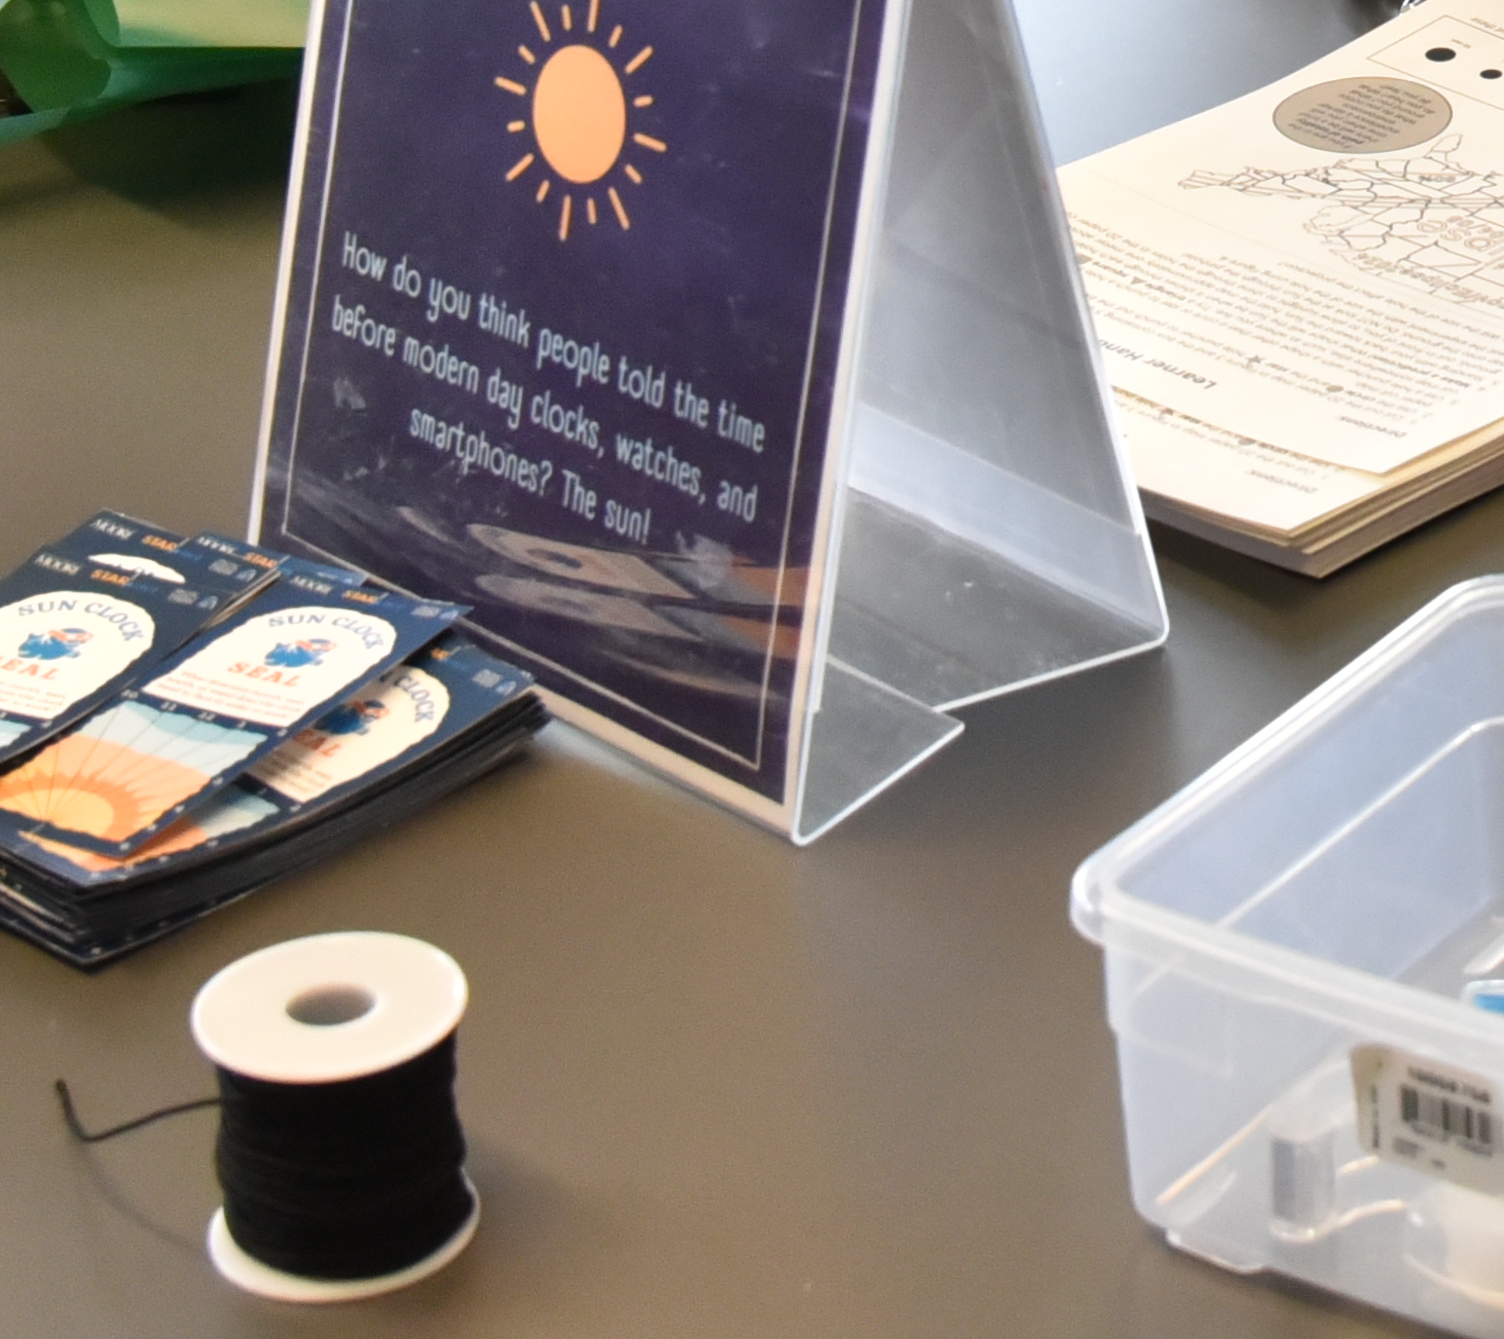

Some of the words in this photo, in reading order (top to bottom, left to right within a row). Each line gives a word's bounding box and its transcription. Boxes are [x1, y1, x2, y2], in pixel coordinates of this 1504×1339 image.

[342, 231, 386, 281] How
[392, 254, 422, 299] do
[428, 277, 471, 323] you
[478, 292, 531, 351] think
[537, 327, 612, 388] people
[618, 354, 665, 411] told
[674, 378, 710, 429] the
[717, 400, 766, 454] time
[1148, 358, 1216, 390] Learner
[331, 295, 397, 355] before
[402, 335, 480, 395] modern
[487, 370, 524, 424] day
[530, 392, 605, 461] clocks,
[615, 432, 705, 504] watches,
[717, 473, 758, 524] and
[1335, 415, 1408, 438] Directions:
[409, 406, 554, 497] smartphones?
[562, 470, 597, 522] The
[605, 498, 652, 545] sun!
[90, 569, 131, 586] STAR
[17, 599, 78, 617] SUN
[84, 601, 144, 642] CLOCK
[268, 613, 327, 628] SUN
[331, 614, 384, 651] CLOCK
[227, 661, 301, 687] SEAL
